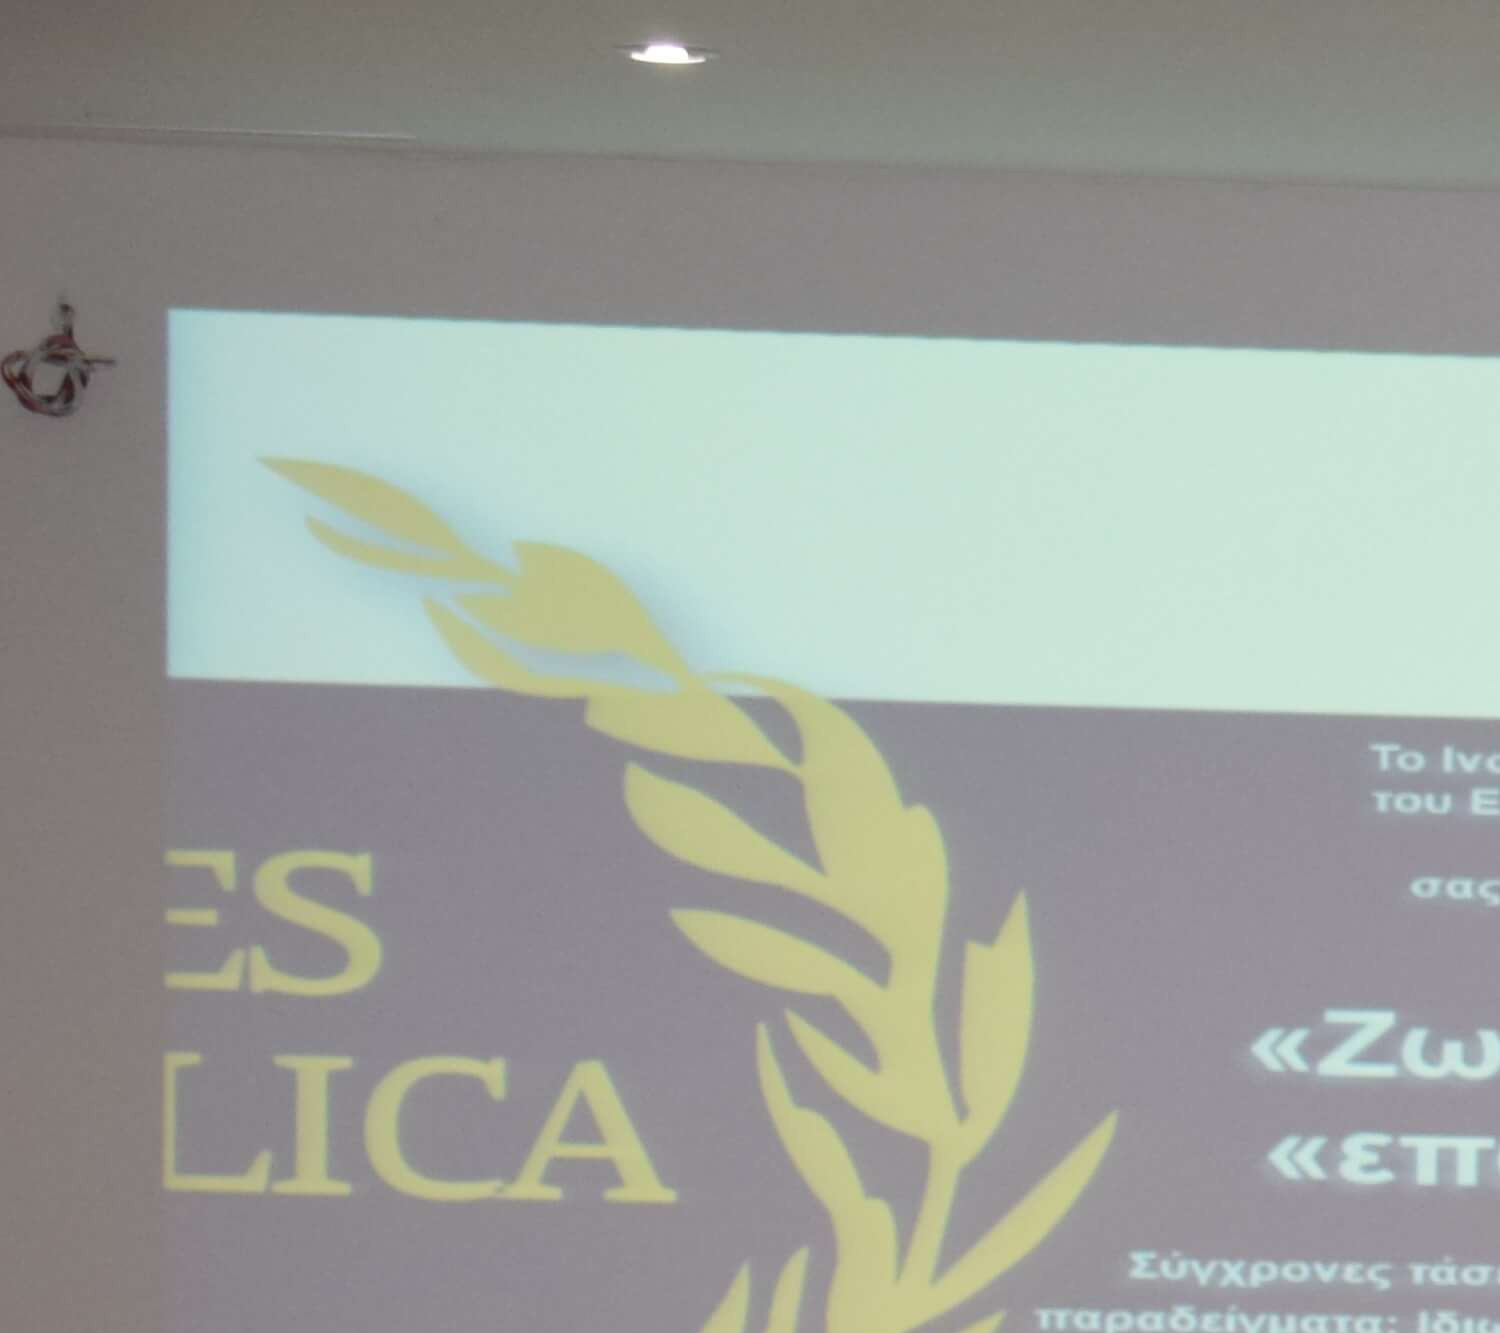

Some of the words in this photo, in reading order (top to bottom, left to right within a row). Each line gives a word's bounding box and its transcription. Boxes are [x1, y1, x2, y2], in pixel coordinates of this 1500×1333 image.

[1369, 743, 1427, 773] Το
[1373, 791, 1453, 815] του
[1128, 1250, 1392, 1291] Σύγχρονες
